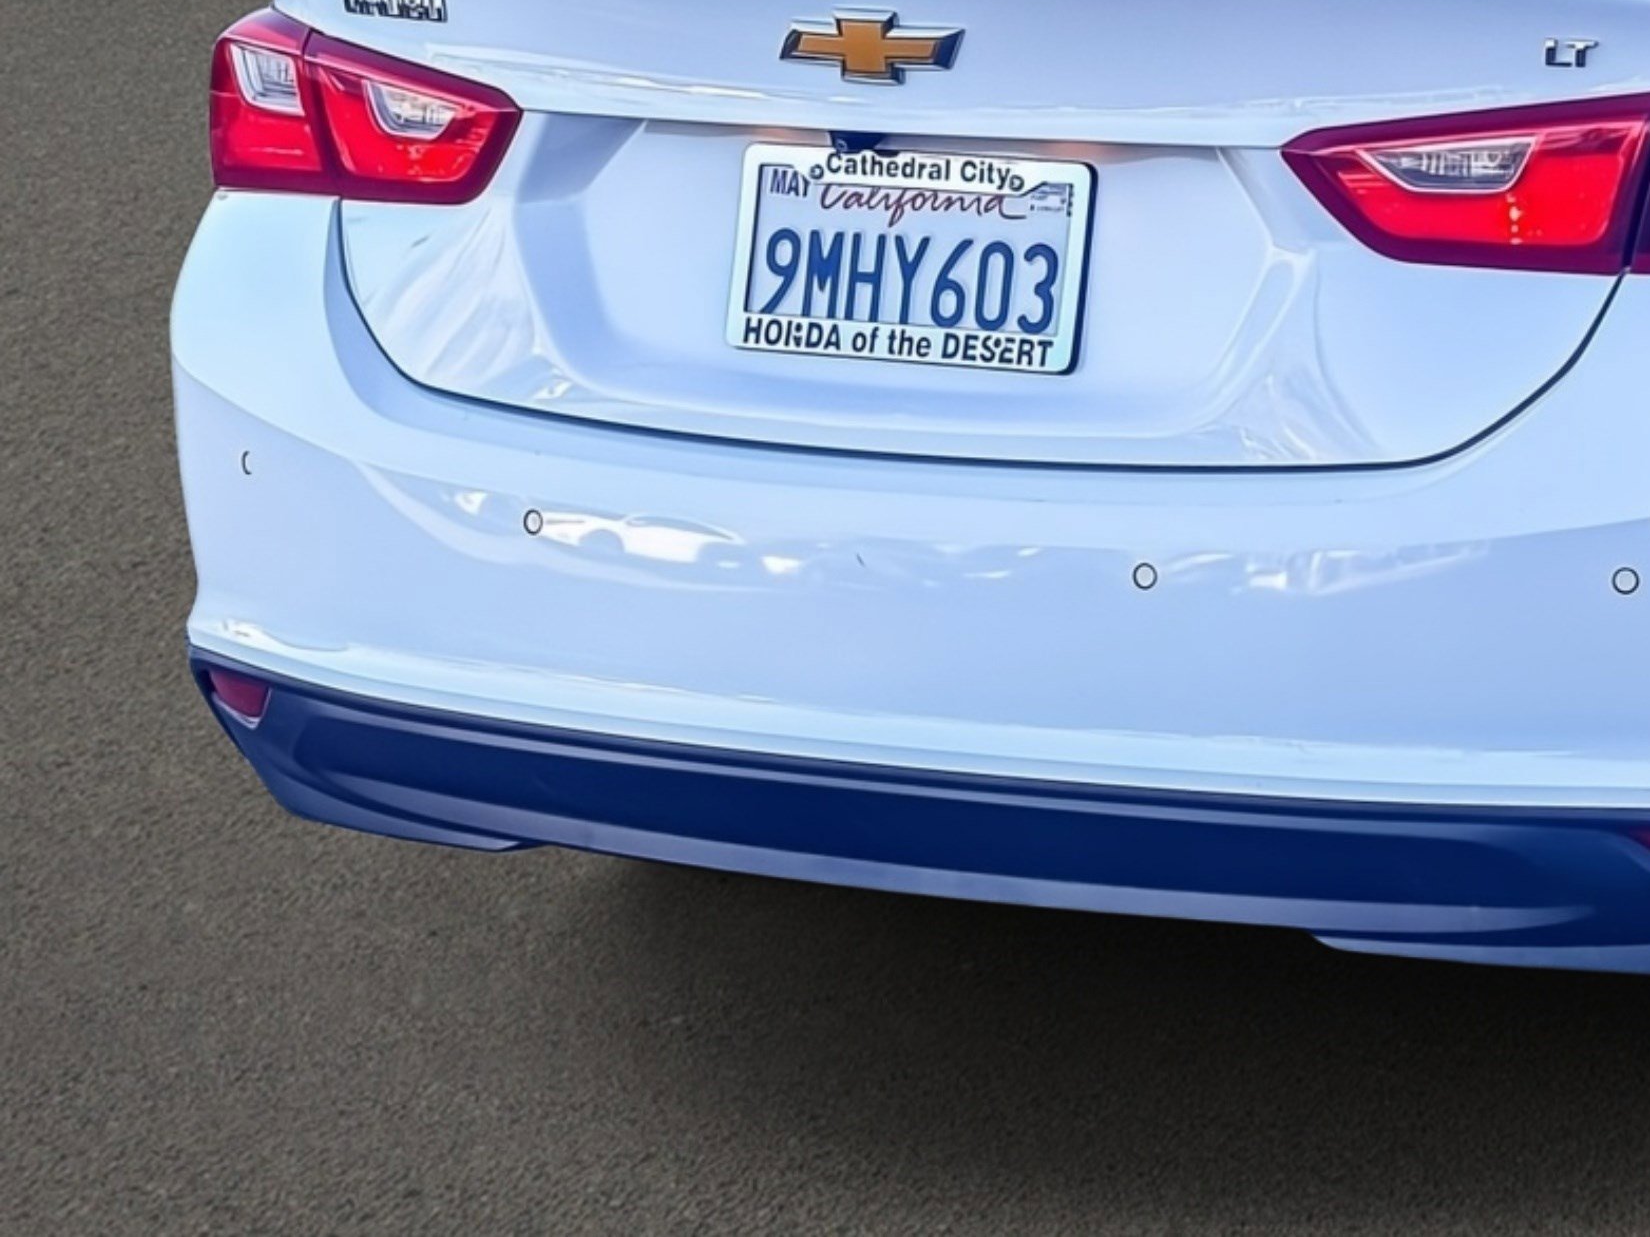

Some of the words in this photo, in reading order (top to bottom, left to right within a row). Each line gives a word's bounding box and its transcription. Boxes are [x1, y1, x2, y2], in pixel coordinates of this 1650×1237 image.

[1544, 38, 1600, 68] LT
[769, 167, 811, 198] MAY
[826, 151, 952, 182] Cathedral
[960, 159, 1011, 191] City
[820, 183, 1028, 229] California
[759, 228, 1059, 335] 9MHY603
[742, 316, 842, 351] HONDA
[851, 325, 880, 354] of
[887, 328, 932, 358] the
[940, 332, 1055, 368] DESERT
